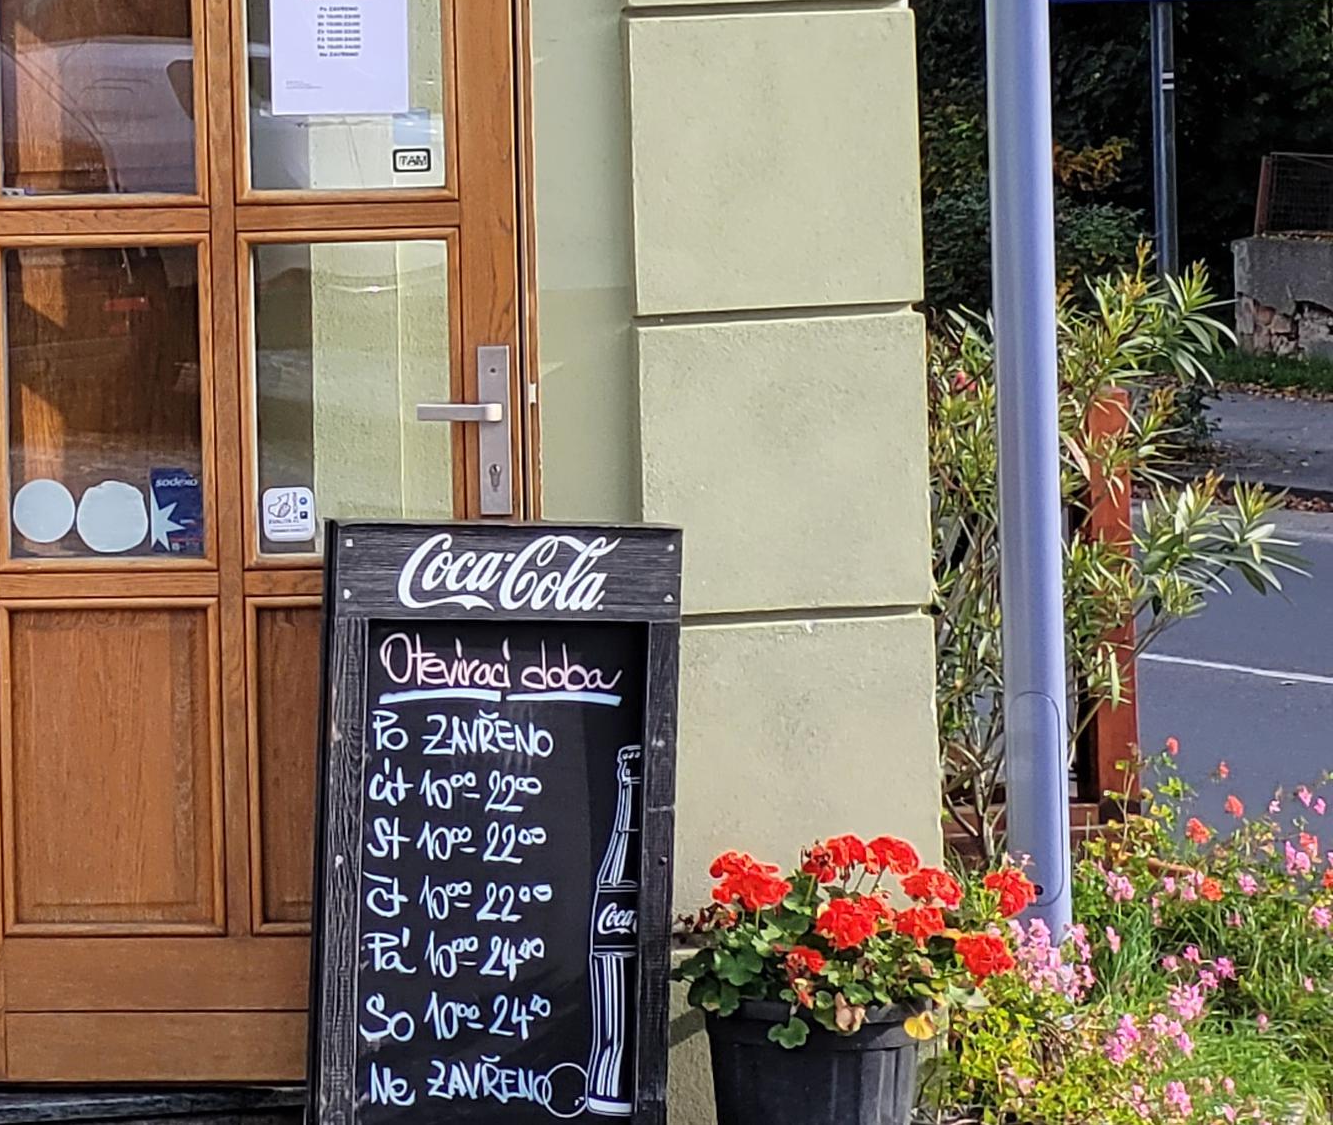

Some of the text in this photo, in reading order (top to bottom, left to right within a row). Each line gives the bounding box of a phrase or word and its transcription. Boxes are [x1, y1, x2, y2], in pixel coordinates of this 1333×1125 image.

[399, 155, 427, 166] TAM
[155, 477, 198, 487] sodexo
[398, 533, 621, 611] Coca-Cola
[521, 639, 622, 691] doba
[372, 708, 554, 757] Po ZAVŘENO
[366, 817, 411, 860] St
[362, 926, 417, 973] Pá
[359, 993, 415, 1042] So
[369, 1054, 552, 1107] Ne ZAVŘENO
